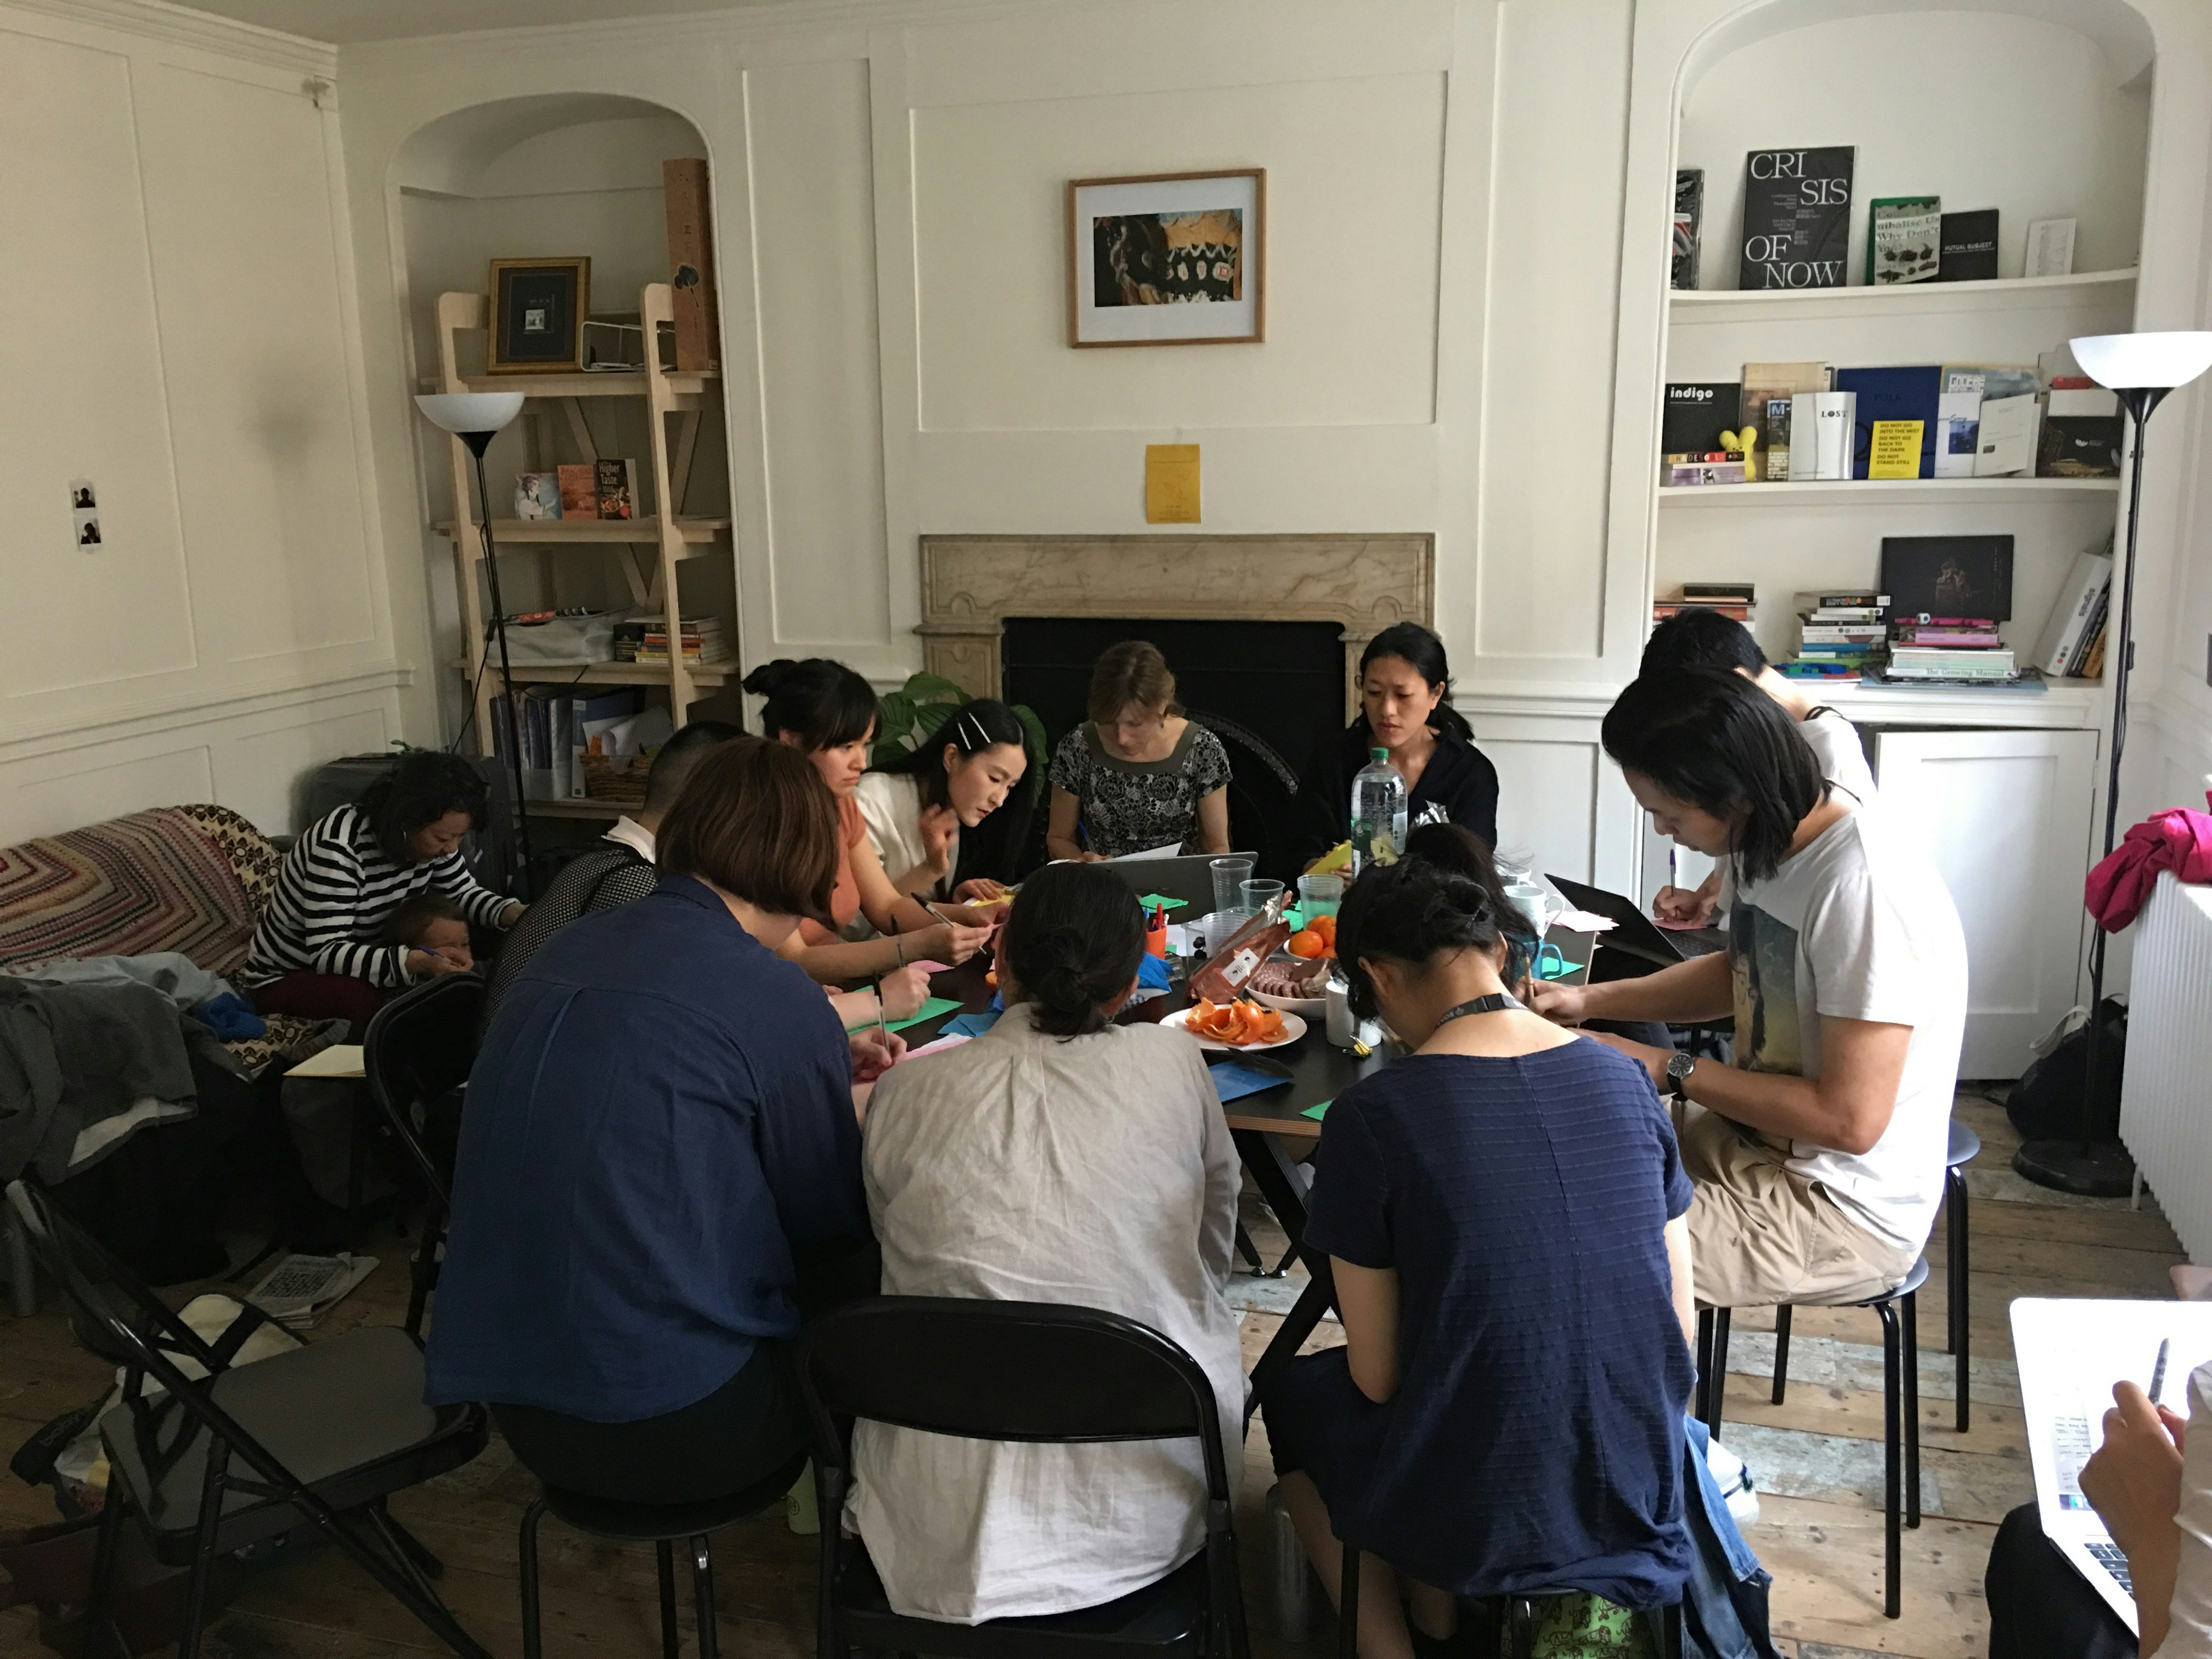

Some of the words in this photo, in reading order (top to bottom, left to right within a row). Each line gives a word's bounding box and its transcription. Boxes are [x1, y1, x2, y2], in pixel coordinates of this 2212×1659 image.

[1751, 151, 1808, 179] CRI
[1801, 178, 1848, 205] SIS
[1877, 232, 1903, 241] Why
[1746, 234, 1792, 262] OF
[1967, 241, 1993, 250] SUBJECT
[1762, 261, 1844, 289] NOW
[1671, 387, 1713, 400] indigo
[1821, 410, 1848, 418] LOST
[599, 461, 620, 476] Higher
[600, 473, 618, 485] Taste
[1941, 669, 1973, 678] Growing
[1976, 669, 2005, 677] Manual
